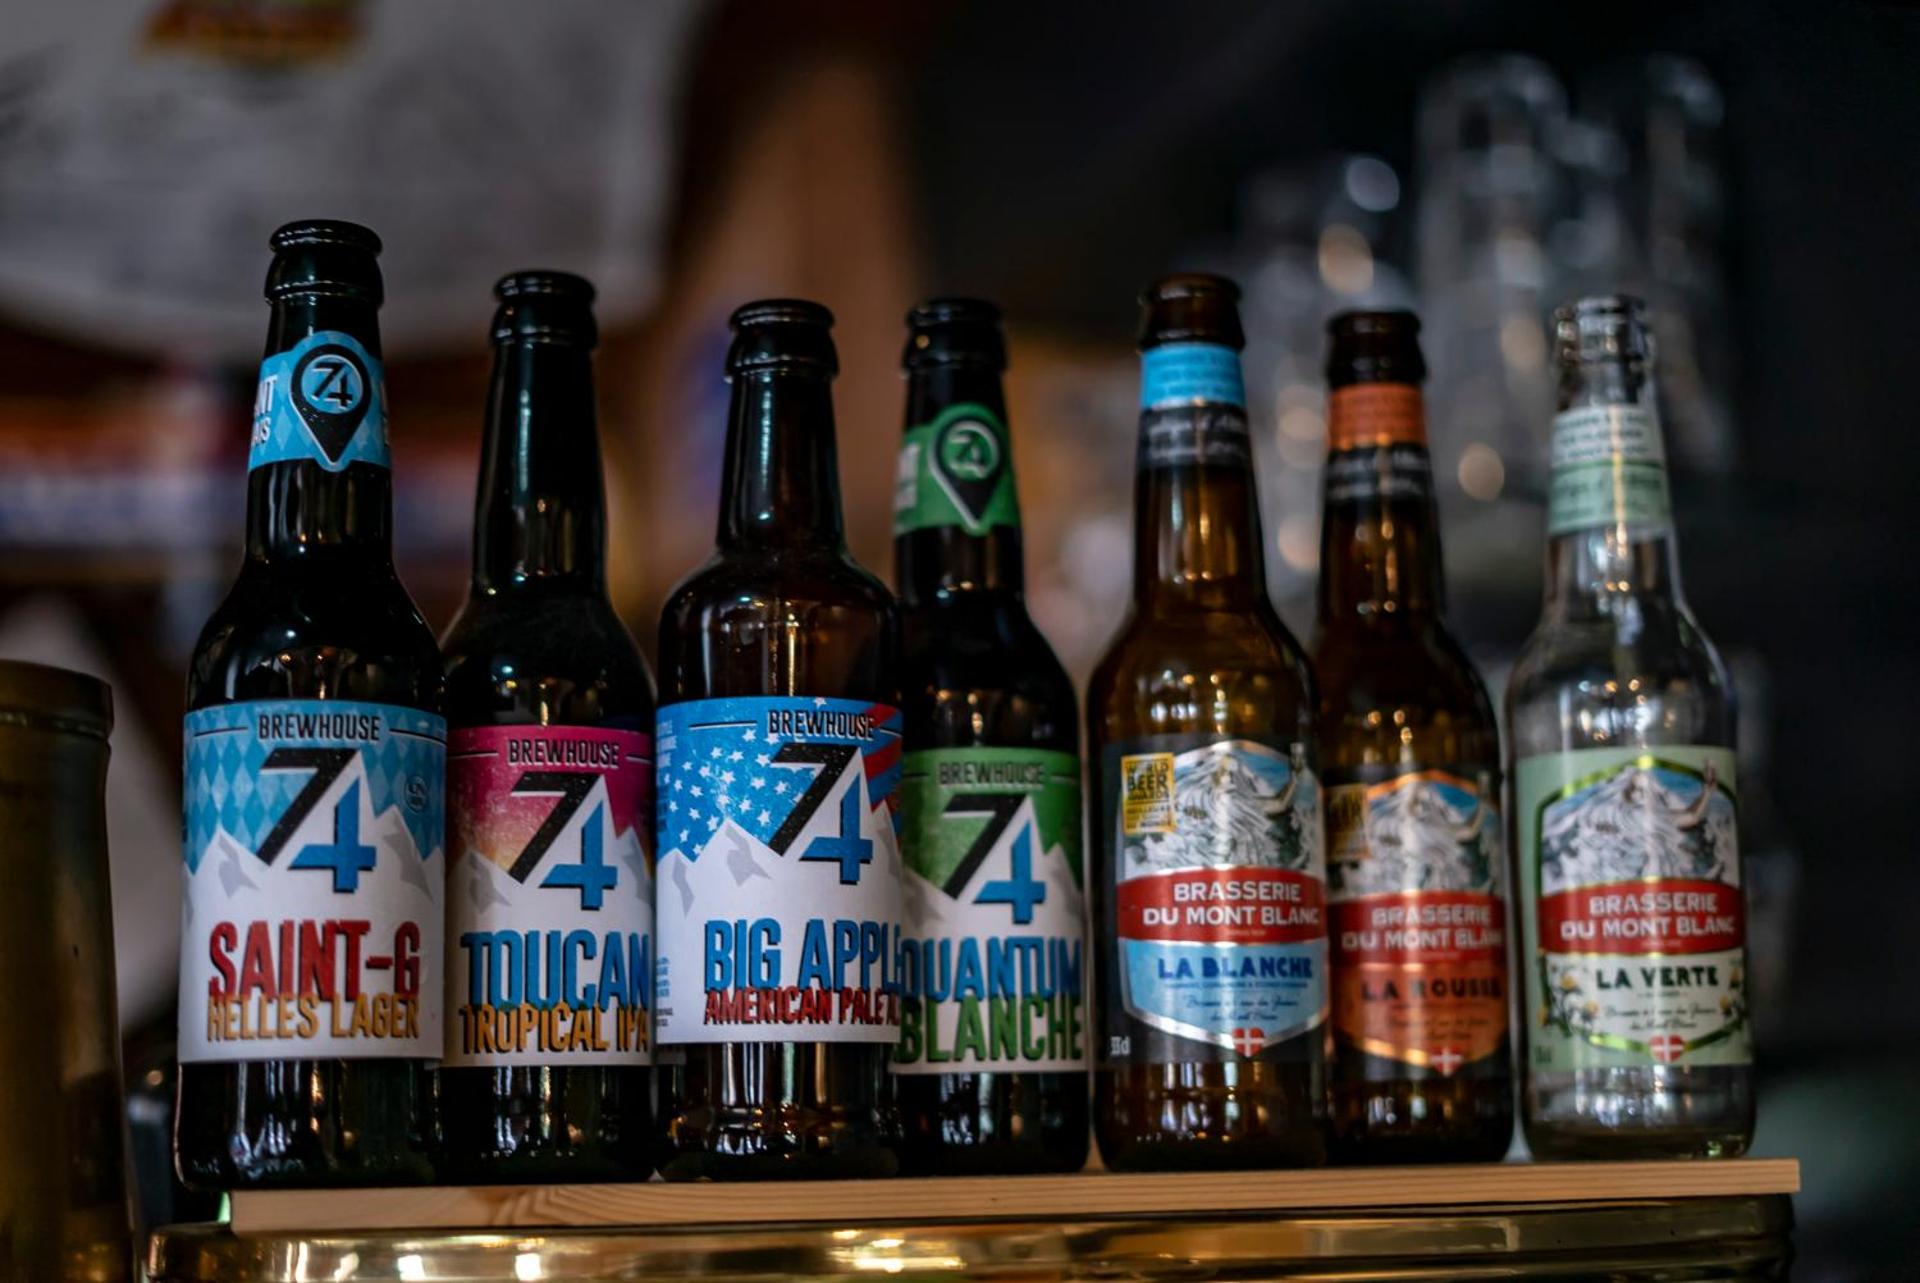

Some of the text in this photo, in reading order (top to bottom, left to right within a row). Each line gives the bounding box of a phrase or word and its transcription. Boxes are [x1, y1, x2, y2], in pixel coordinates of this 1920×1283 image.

[259, 714, 381, 741] BREWHOUSE
[768, 709, 875, 740] BREWHOUSE
[509, 739, 620, 768] BREWHOUSE
[939, 761, 1045, 787] BREWHOUSE
[259, 748, 377, 893] 74
[768, 742, 874, 885] 74
[508, 771, 618, 910] 74
[943, 793, 1046, 924] 74
[1173, 880, 1302, 902] BRASSERIE
[1589, 892, 1719, 917] BRASSERIE
[1142, 906, 1319, 926] DU MONT BLANC
[1371, 905, 1491, 927] BRASSERIE
[1560, 915, 1736, 940] DU MONT BLANC
[1342, 930, 1378, 949] DU
[1385, 928, 1450, 949] MONT
[208, 920, 421, 1003] SAINT-G
[704, 917, 782, 993] BIG
[900, 936, 1082, 1003] QUANTUM
[1158, 956, 1313, 979] LA BLANCHE
[460, 930, 650, 1013] TOUCAN
[1596, 966, 1719, 989] LA VERTE
[1361, 979, 1399, 1000] LA
[207, 992, 420, 1042] HELLES LAGER
[703, 986, 832, 1025] AMERICAN
[839, 986, 884, 1026] PALE
[458, 1001, 649, 1054] TROPICAL IPA
[893, 994, 1083, 1063] BLANCHE
